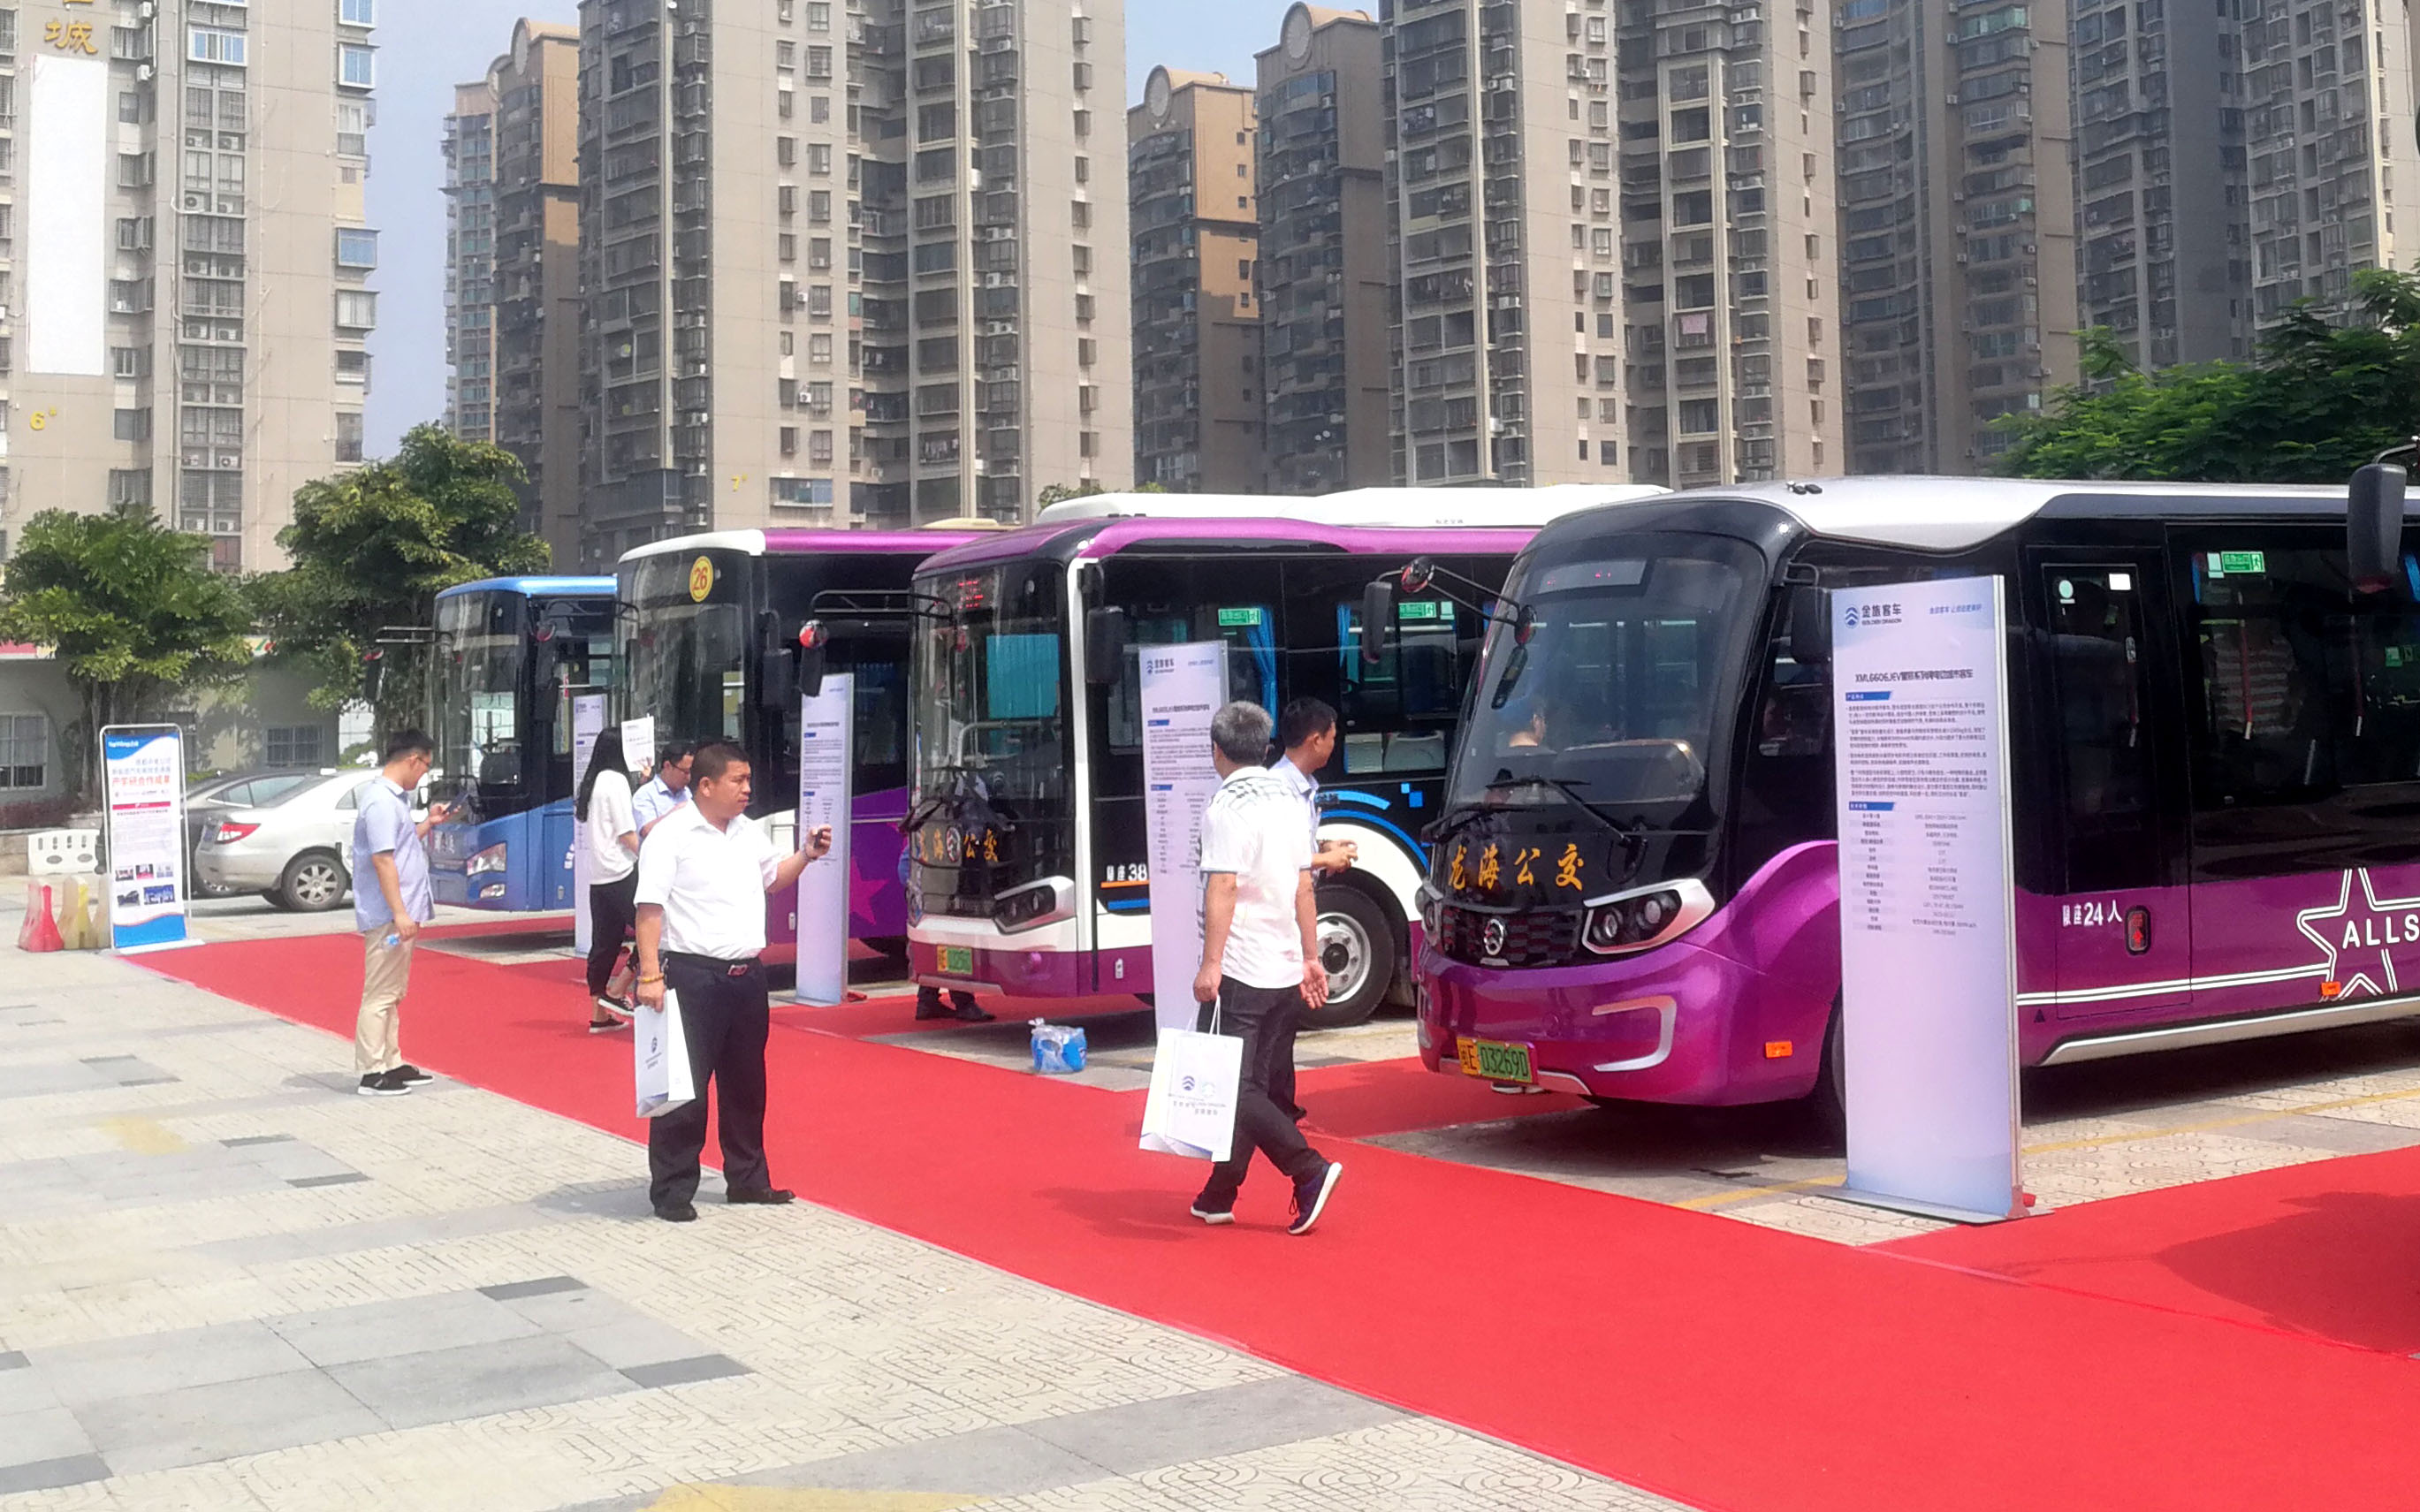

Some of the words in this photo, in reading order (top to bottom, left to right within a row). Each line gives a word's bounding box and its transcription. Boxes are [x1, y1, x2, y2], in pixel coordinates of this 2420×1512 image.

[44, 0, 98, 54] 城
[692, 566, 708, 590] 26
[1861, 604, 1902, 618] 金旅客车
[1449, 842, 1585, 892] 龙海公交
[2342, 914, 2420, 949] ALLS
